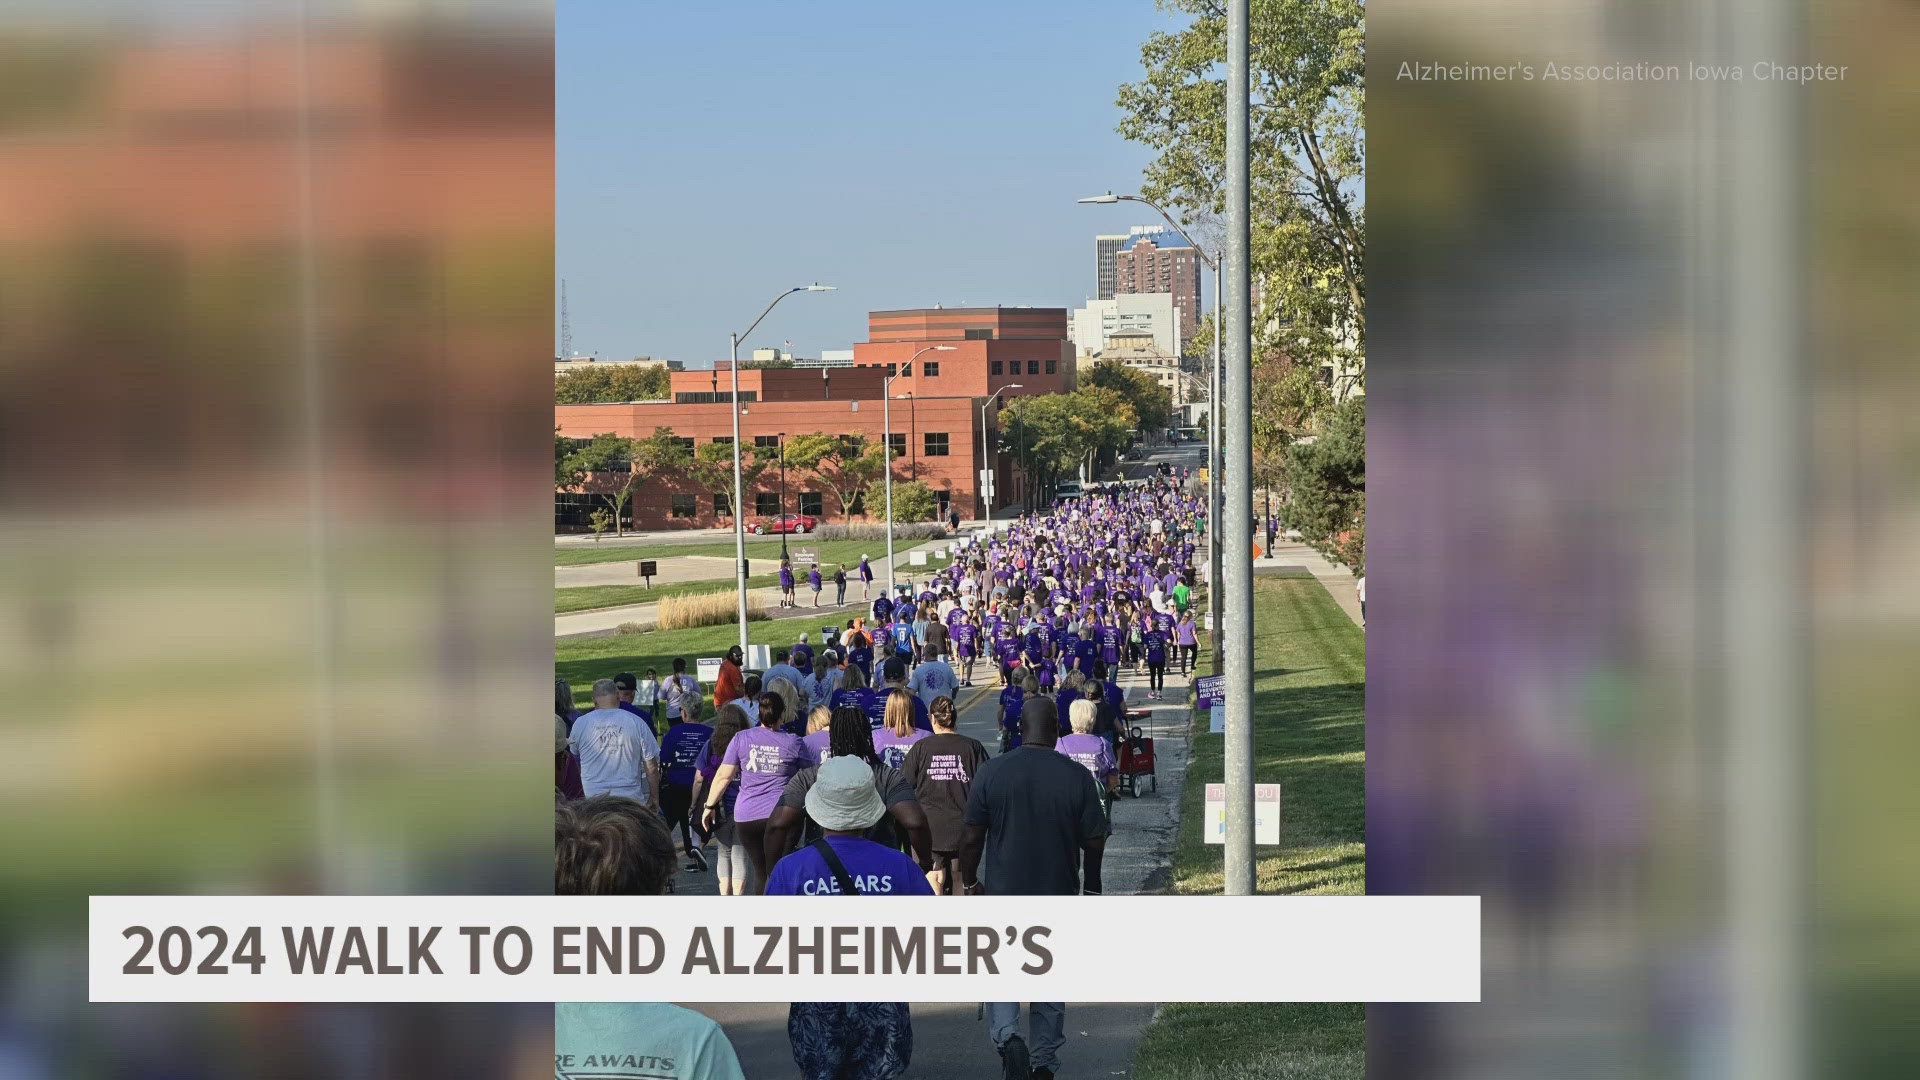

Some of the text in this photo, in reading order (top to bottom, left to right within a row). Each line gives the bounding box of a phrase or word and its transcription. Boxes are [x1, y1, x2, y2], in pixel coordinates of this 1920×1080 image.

[1257, 788, 1273, 799] OU
[803, 874, 892, 896] CAEARS
[555, 1054, 676, 1071] RE AWAITS
